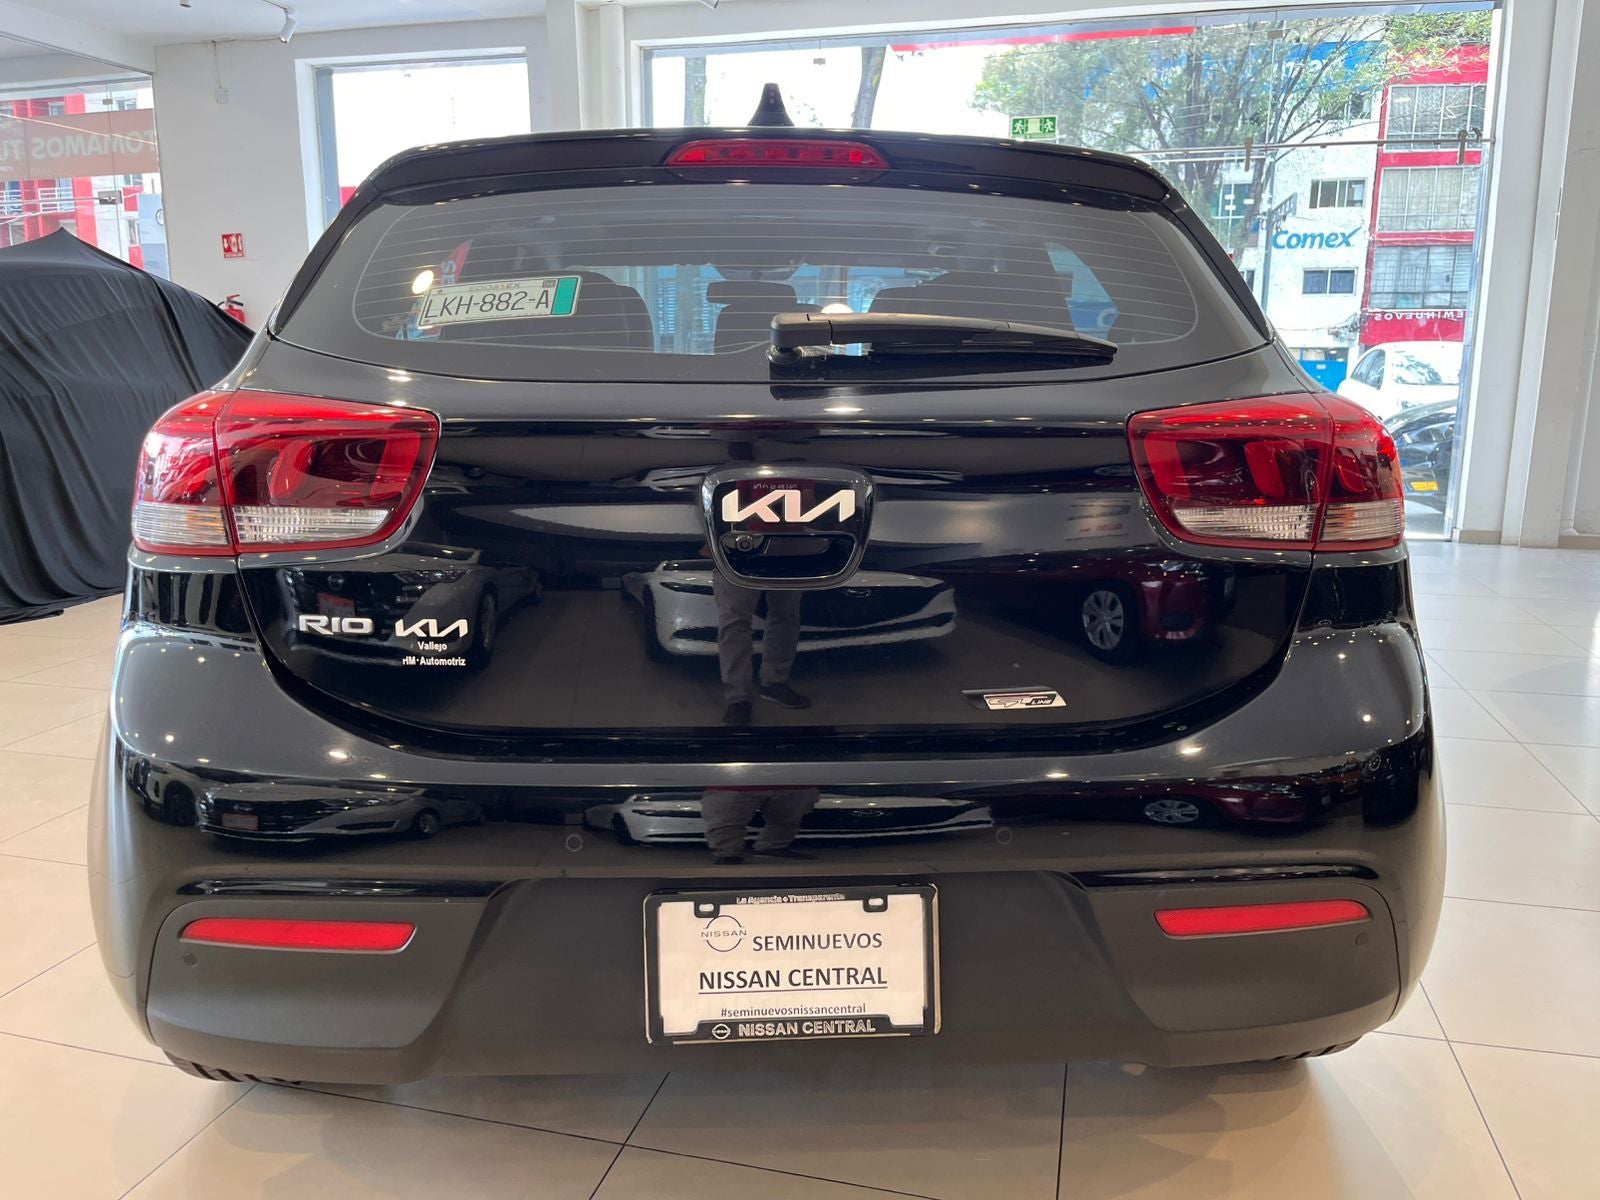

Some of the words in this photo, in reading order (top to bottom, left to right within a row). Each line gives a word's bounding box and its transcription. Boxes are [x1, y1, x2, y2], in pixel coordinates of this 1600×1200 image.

[1272, 226, 1362, 249] Comex
[424, 289, 549, 318] LKH-882-A
[722, 489, 855, 523] KIA
[299, 614, 374, 635] RIO
[395, 618, 468, 637] KIA
[417, 641, 448, 652] Vallejo
[701, 930, 747, 938] NISSAN
[753, 933, 882, 952] SEMINUEVOS
[699, 970, 780, 990] NISSAN
[788, 967, 887, 987] CENTRAL
[720, 1003, 866, 1018] #seminuevosnissancentral
[738, 1022, 798, 1037] NISSAN
[802, 1019, 876, 1034] CENTRAL
